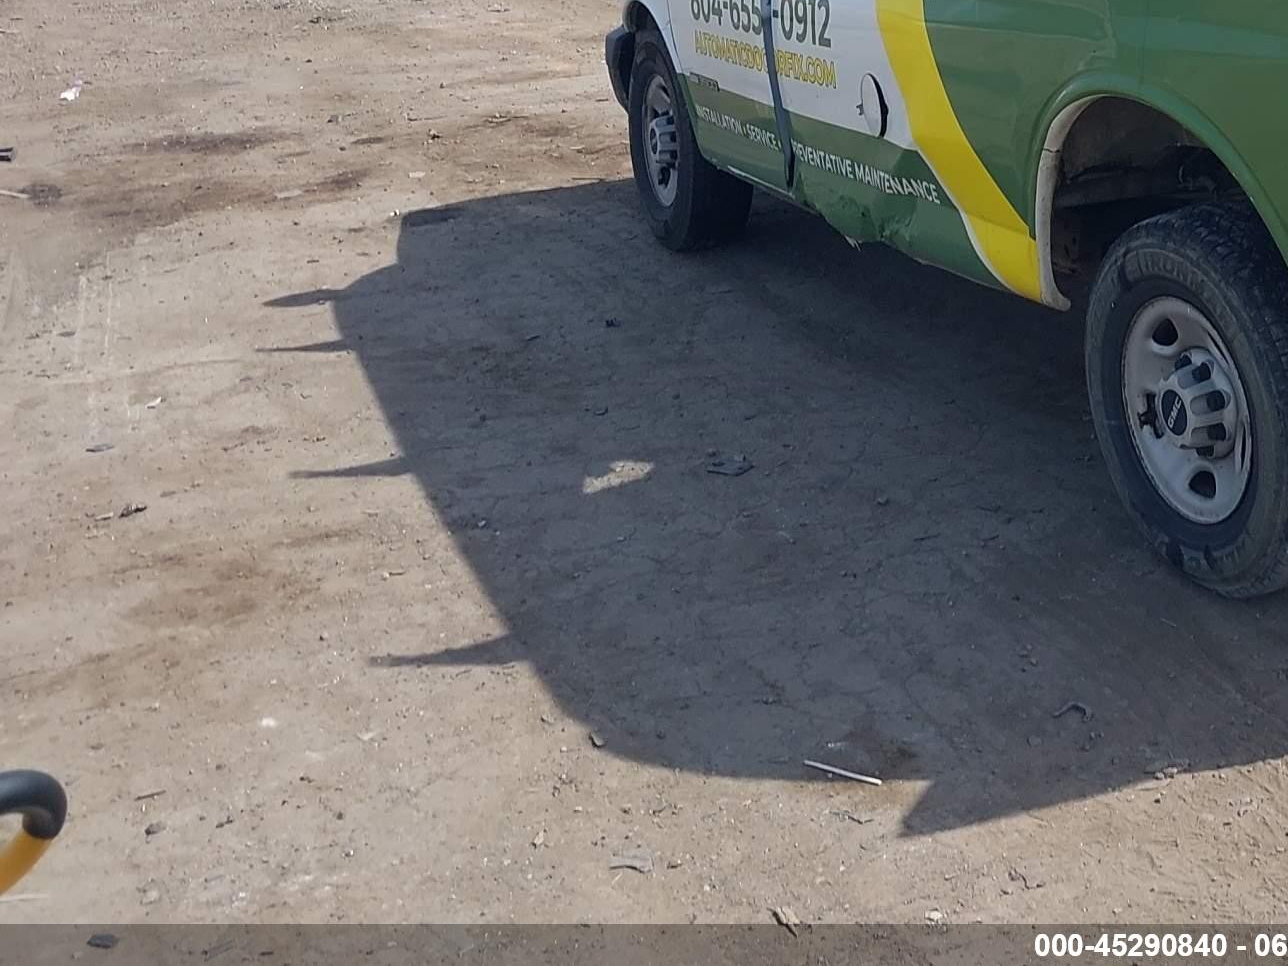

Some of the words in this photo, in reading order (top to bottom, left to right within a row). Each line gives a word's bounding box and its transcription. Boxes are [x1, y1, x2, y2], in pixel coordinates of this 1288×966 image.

[746, 123, 779, 151] SERVICE
[854, 164, 941, 205] MAINTENANCE
[1167, 395, 1182, 429] GMC
